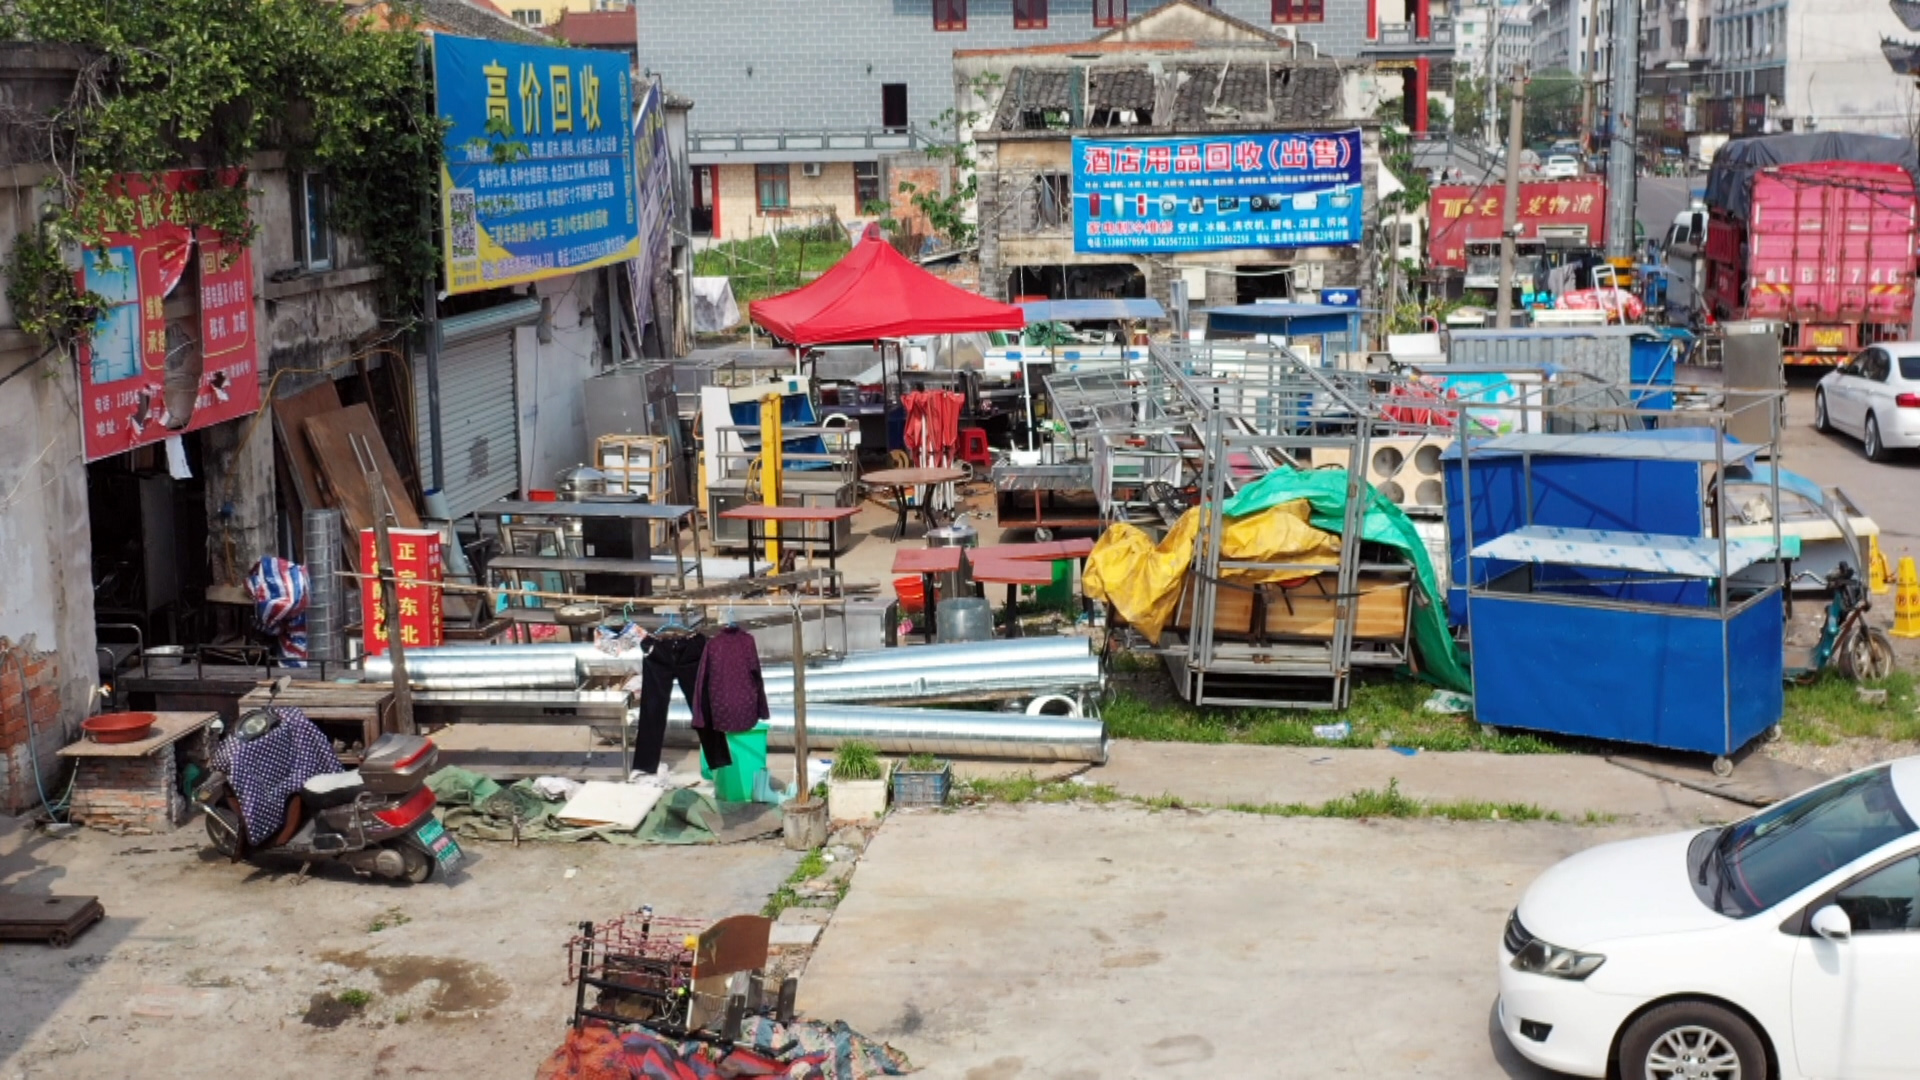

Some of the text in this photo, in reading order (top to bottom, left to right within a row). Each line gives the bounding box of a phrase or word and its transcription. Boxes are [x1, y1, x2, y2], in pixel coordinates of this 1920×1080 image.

[483, 59, 602, 134] 高价回收
[1084, 137, 1351, 174] 酒店用品回收(出售)
[397, 542, 419, 644] 正宗东北
